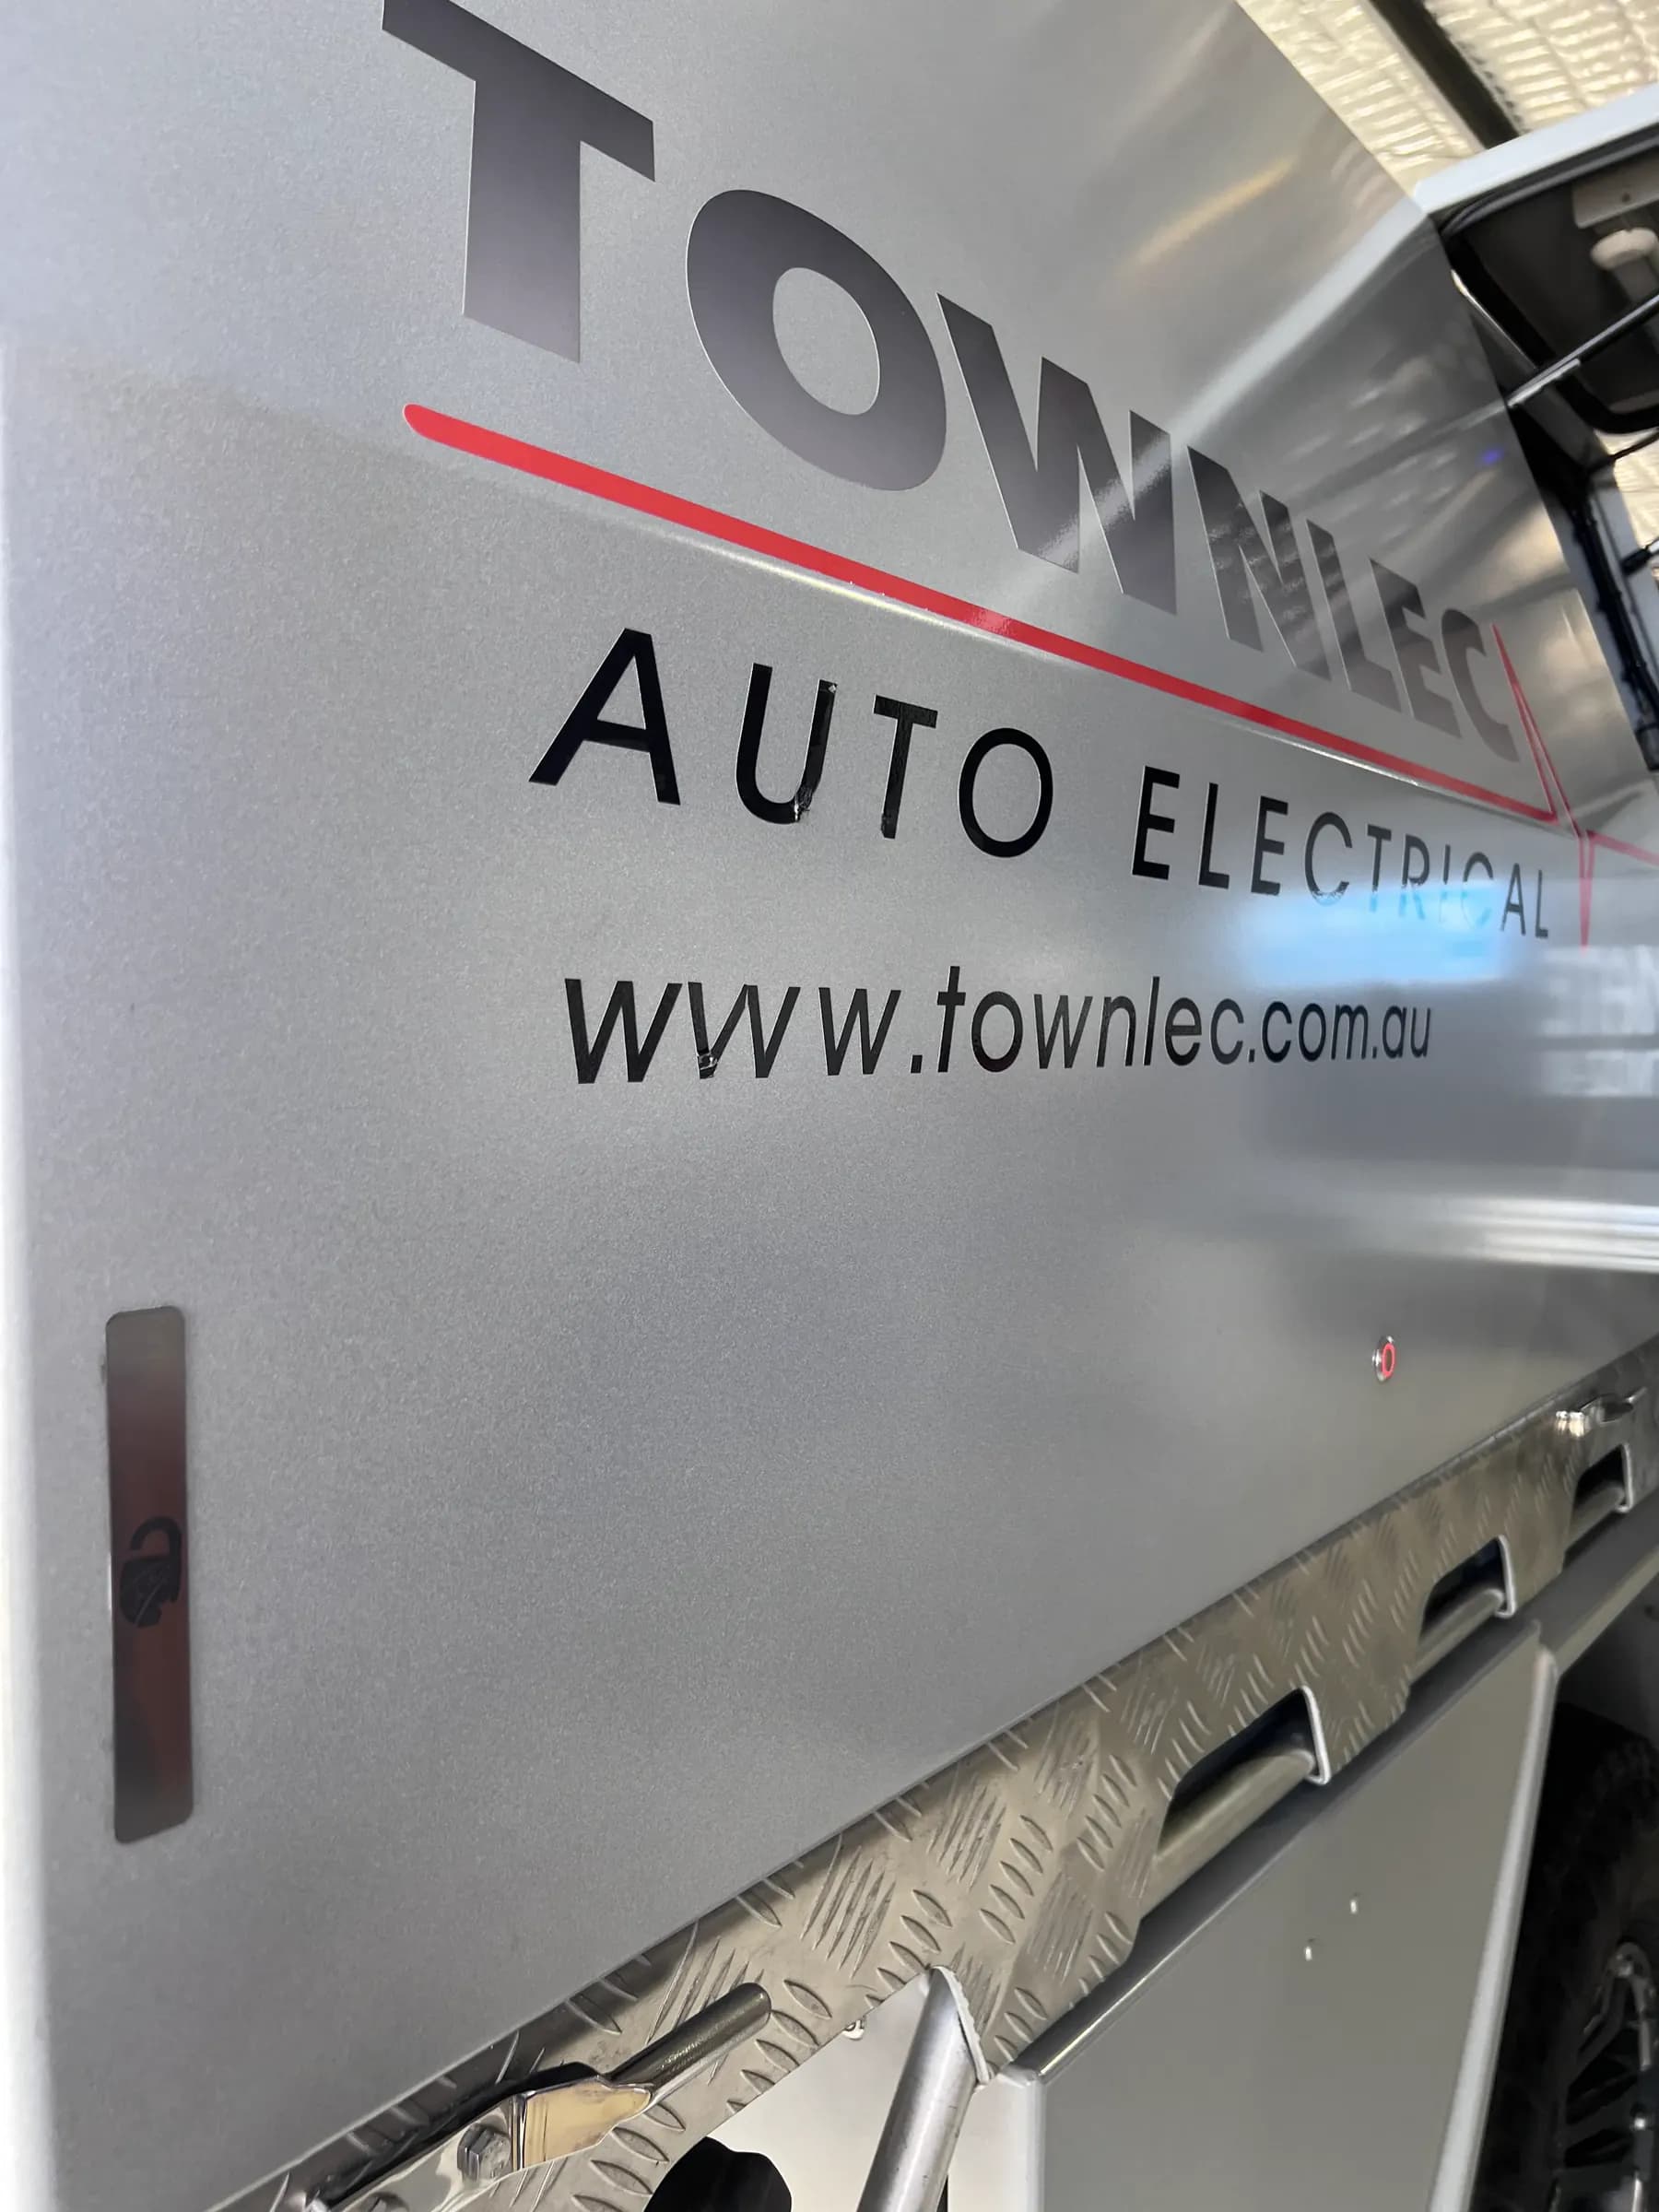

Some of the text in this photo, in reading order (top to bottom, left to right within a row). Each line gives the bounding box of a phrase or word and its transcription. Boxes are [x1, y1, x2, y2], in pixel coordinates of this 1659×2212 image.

[382, 0, 1521, 763] TOWNLEC
[528, 628, 1549, 940] AUTO ELECTRICAL
[564, 966, 1431, 1085] www.townlec.com.au
